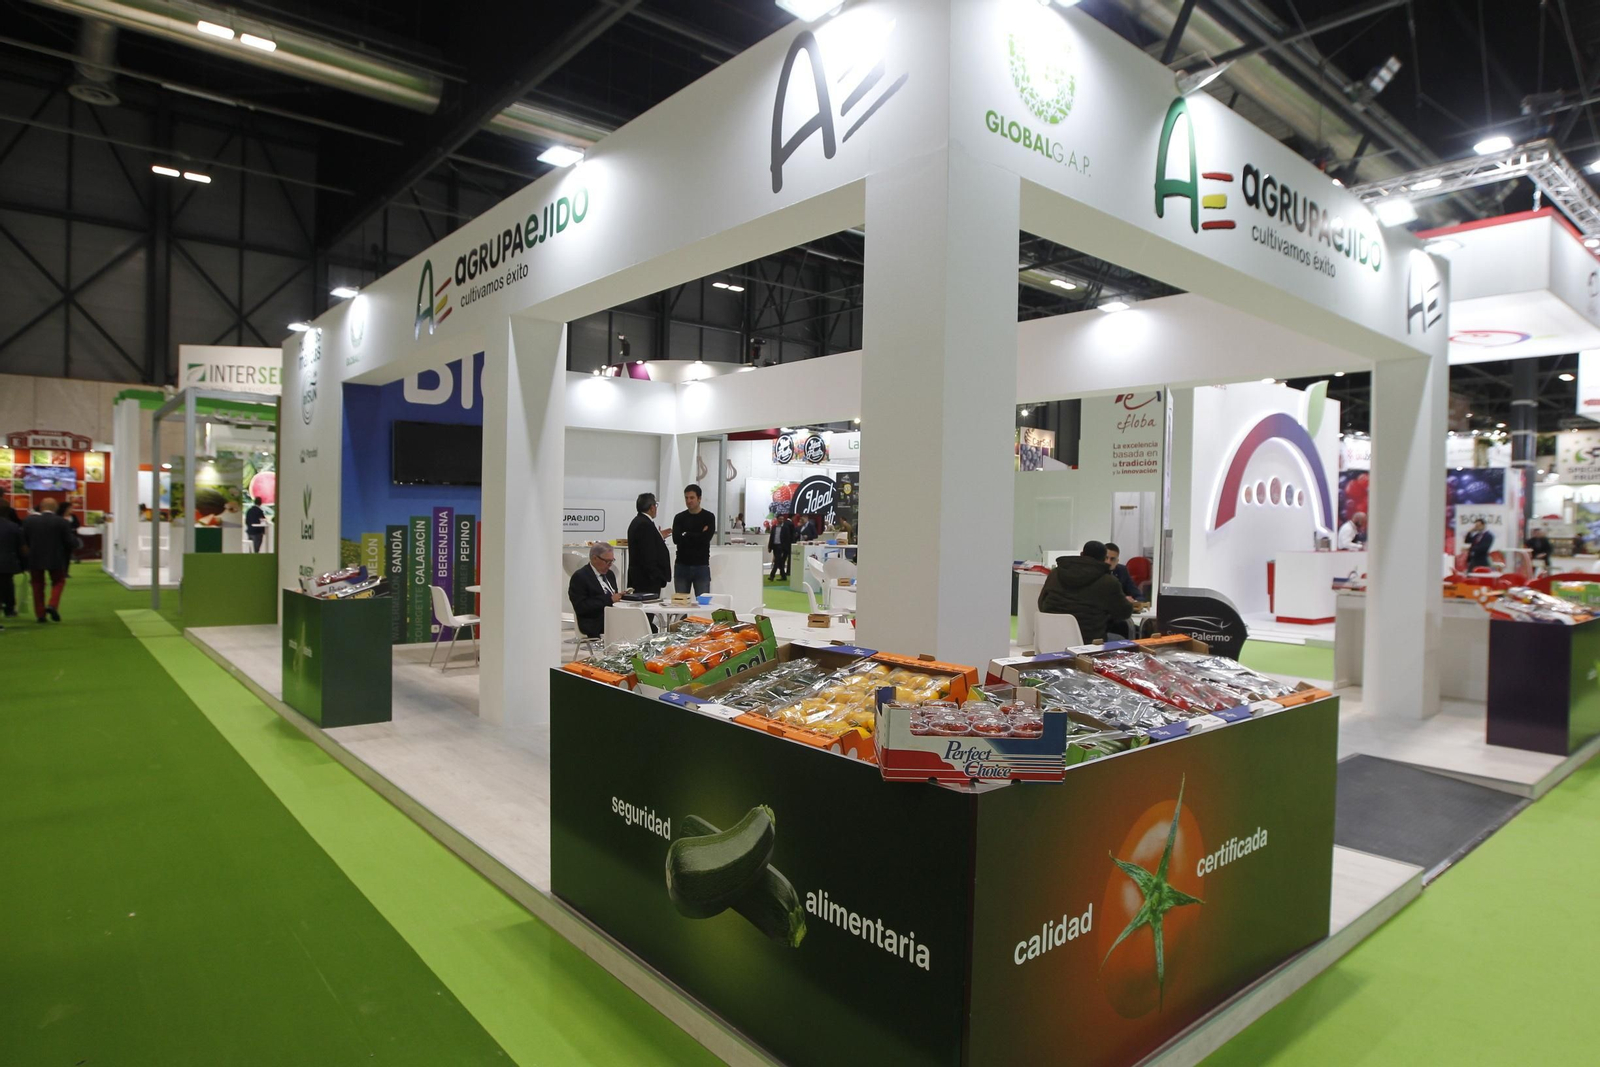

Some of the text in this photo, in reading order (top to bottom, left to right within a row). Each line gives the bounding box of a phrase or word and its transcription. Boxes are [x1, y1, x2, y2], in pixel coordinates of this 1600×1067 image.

[1252, 224, 1336, 278] cultivamos éxito
[460, 262, 529, 307] cultivamos éxito
[1113, 450, 1144, 458] basada
[1119, 459, 1158, 467] tradición
[803, 482, 834, 514] Ideal
[390, 530, 402, 573] SANDÍA
[414, 520, 426, 585] CALABACÍN
[438, 510, 449, 578] BERENJENA
[460, 520, 471, 562] PEPINO
[1191, 632, 1232, 642] Palermo
[943, 740, 992, 764] Perfect
[963, 760, 1012, 778] Choice
[611, 796, 671, 841] seguridad
[1196, 826, 1268, 878] certificada
[805, 889, 930, 971] alimentaria
[1014, 902, 1093, 965] calidad
